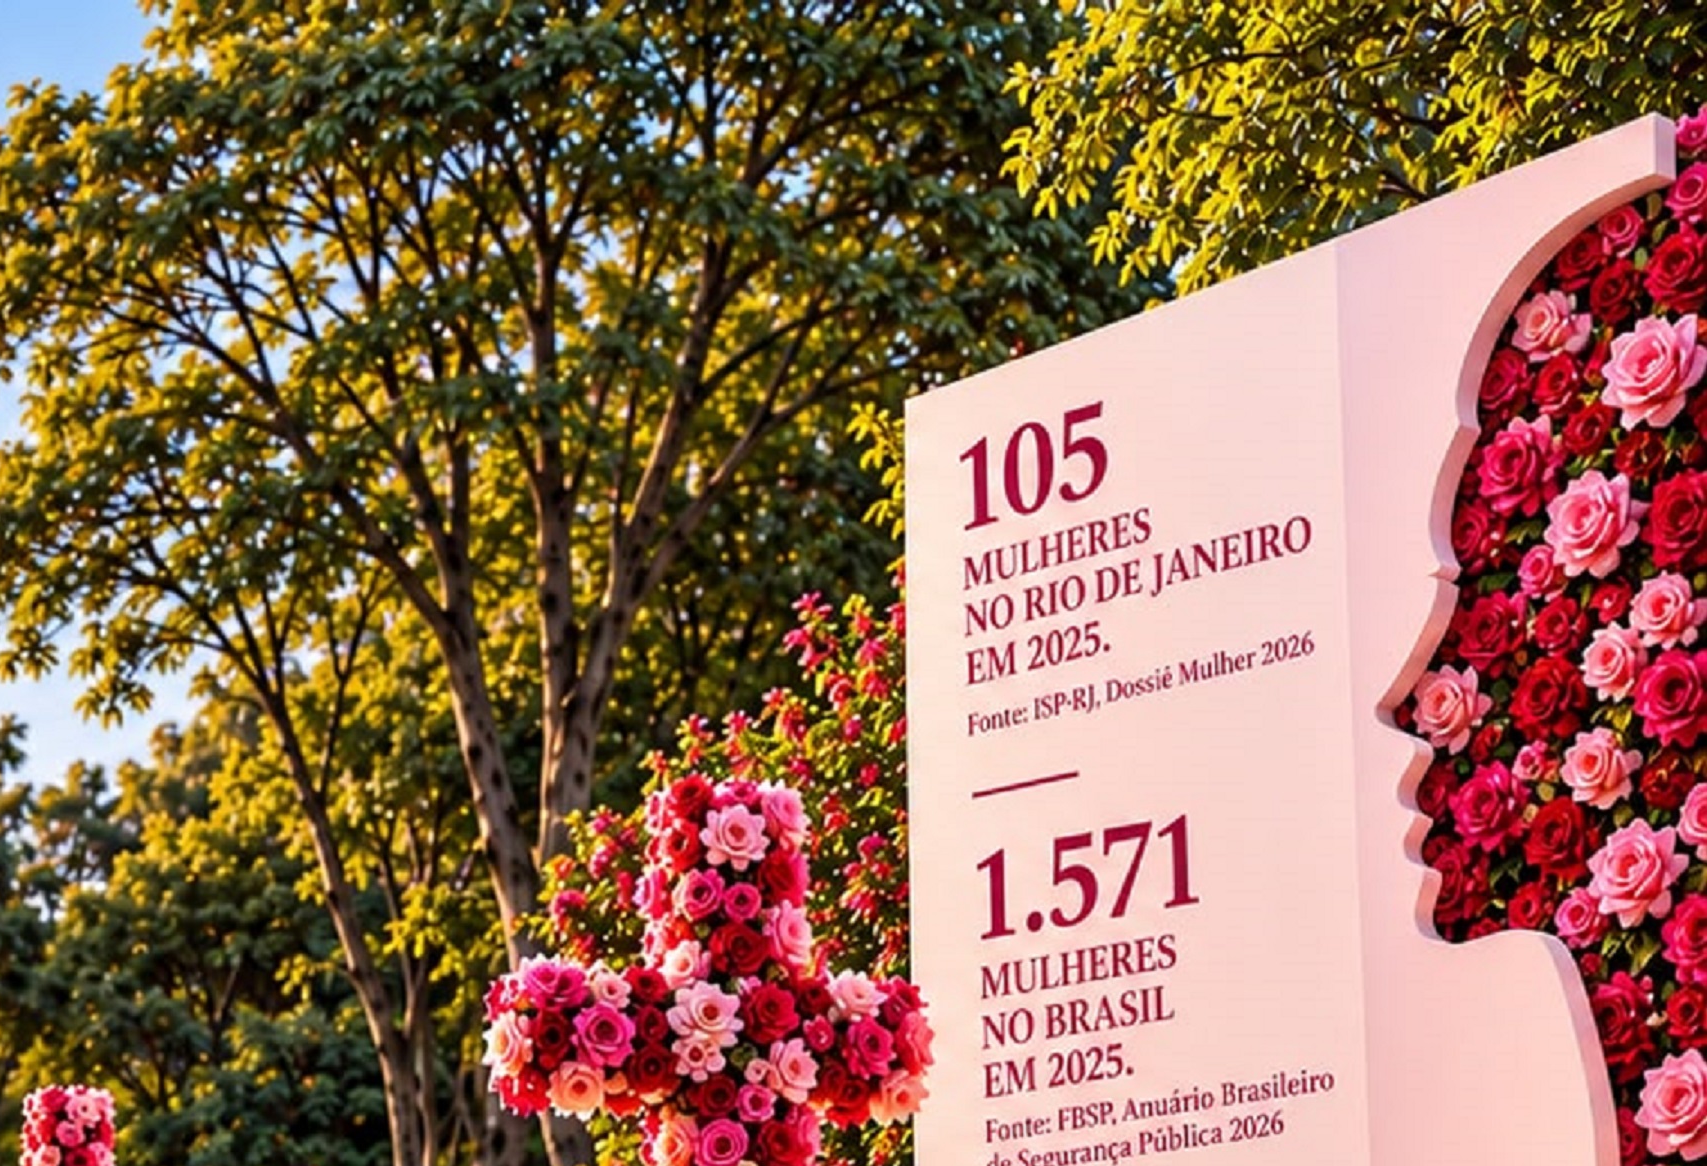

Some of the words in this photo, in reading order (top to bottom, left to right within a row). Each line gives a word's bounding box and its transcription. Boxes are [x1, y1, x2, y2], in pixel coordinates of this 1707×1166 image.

[959, 400, 1108, 531] 105
[964, 508, 1152, 590] MULHERES
[965, 593, 1015, 637] NO
[1024, 575, 1086, 622] RIO
[1095, 558, 1143, 604] DE
[1150, 515, 1312, 598] JANEIRO
[966, 641, 1017, 685] EM
[1027, 620, 1111, 671] 2025.
[967, 707, 1029, 737] Fonte:
[1034, 683, 1101, 721] ISP-RJ,
[1178, 650, 1257, 685] Mulher
[1261, 630, 1315, 666] 2026
[976, 814, 1200, 940] 1.571
[981, 934, 1177, 1000] MULHERES
[982, 1007, 1035, 1050] NO
[1045, 985, 1175, 1040] BRASIL
[984, 1056, 1037, 1099] EM
[1048, 1042, 1134, 1089] 2025.
[985, 1117, 1052, 1144] Fonte:
[1121, 1086, 1215, 1122] Anuário
[1221, 1069, 1335, 1107] Brasileiro
[1138, 1123, 1223, 1156] Pública
[1229, 1109, 1285, 1143] 2026
